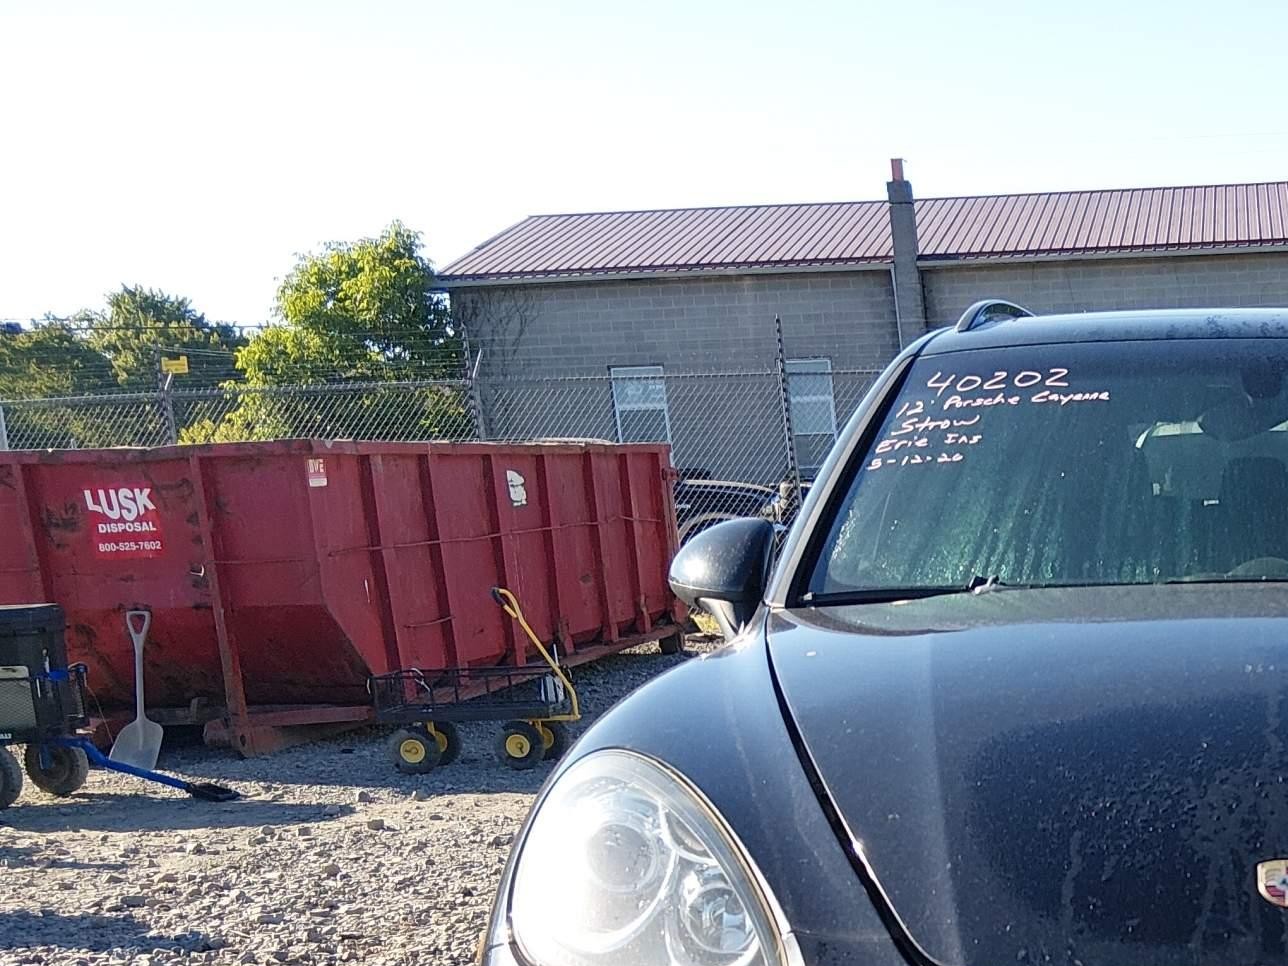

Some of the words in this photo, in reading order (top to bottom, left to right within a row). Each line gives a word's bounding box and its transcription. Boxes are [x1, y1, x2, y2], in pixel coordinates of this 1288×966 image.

[927, 368, 1069, 397] 40202
[943, 392, 1020, 410] Porsche
[875, 436, 928, 453] Erie
[83, 487, 157, 521] LUSK
[97, 521, 157, 533] DISPOSAL
[98, 541, 162, 552] 800-525-7602
